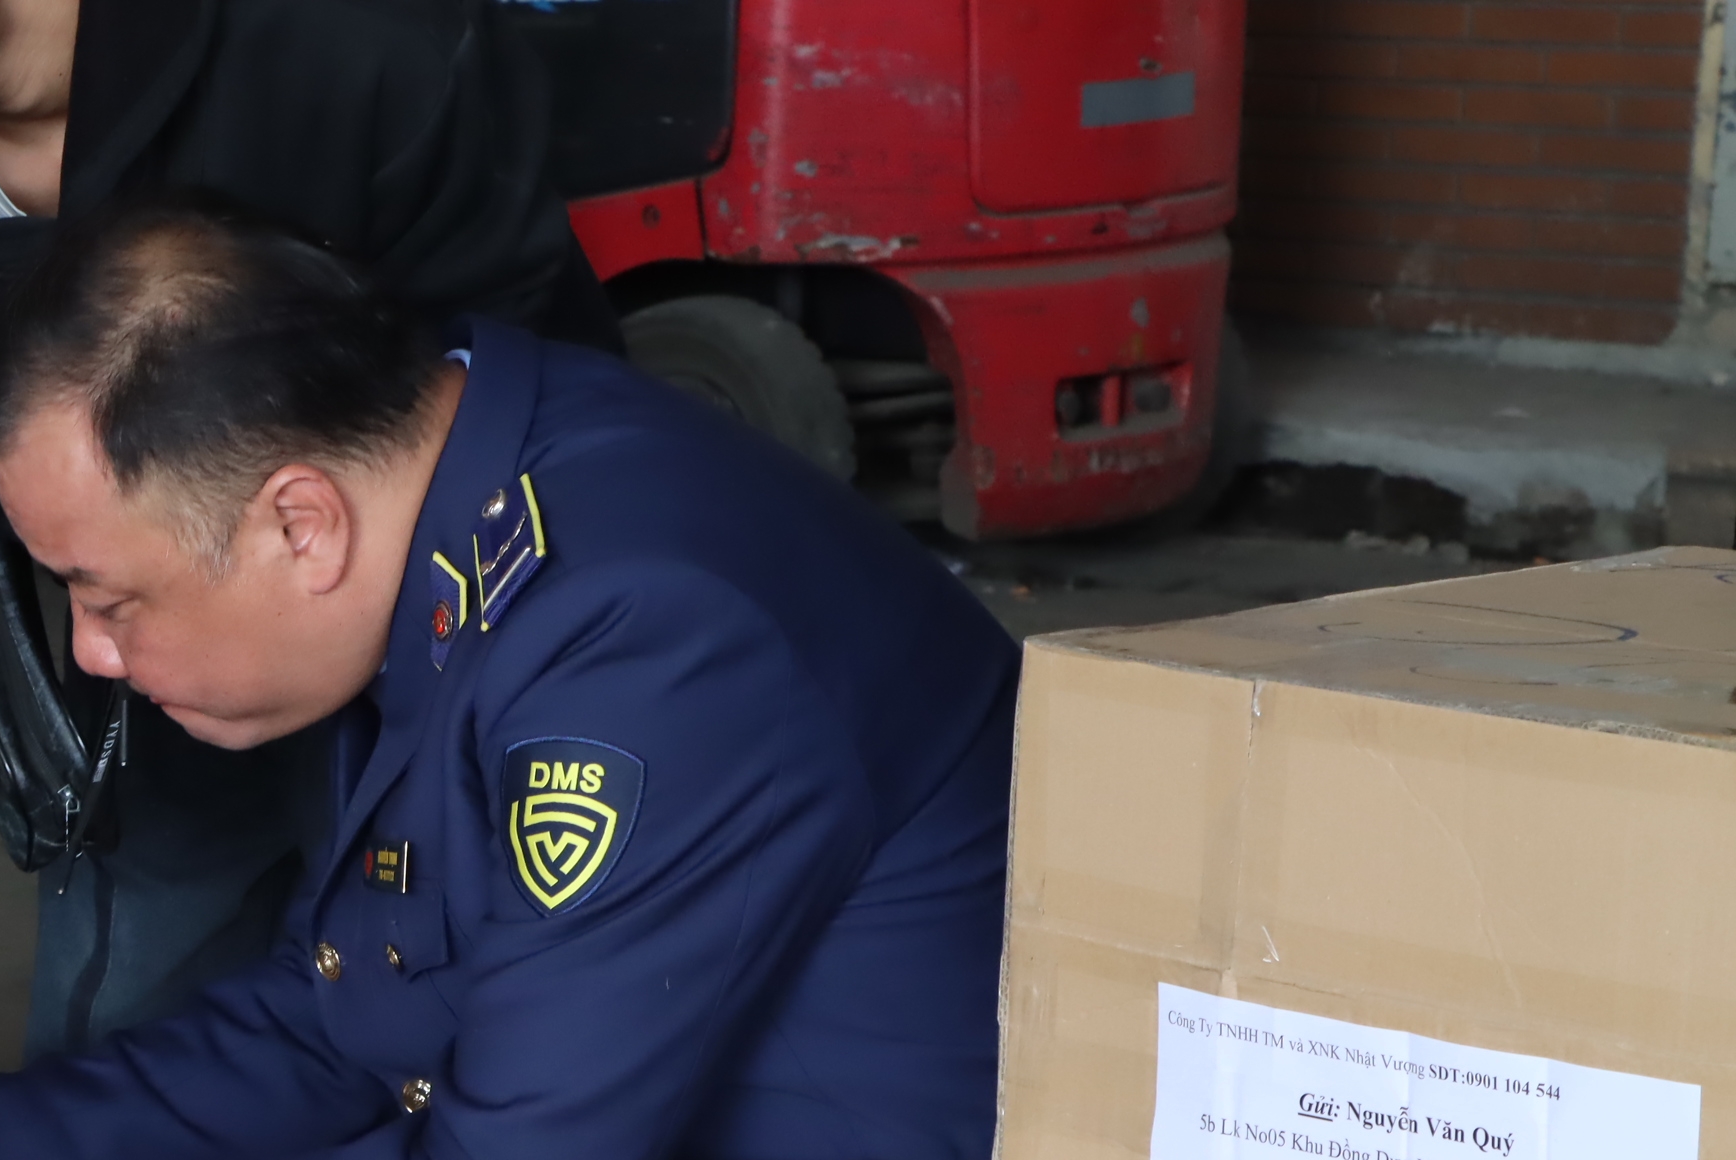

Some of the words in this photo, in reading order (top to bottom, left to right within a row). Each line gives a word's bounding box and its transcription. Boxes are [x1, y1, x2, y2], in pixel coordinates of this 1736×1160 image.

[528, 761, 606, 794] DMS
[1167, 1010, 1196, 1034] Công
[1199, 1018, 1214, 1041] Ty
[1217, 1020, 1258, 1044] TNHH
[1262, 1030, 1284, 1050] TM
[1288, 1037, 1304, 1054] và
[1309, 1041, 1339, 1059] XNK
[1346, 1048, 1375, 1066] Nhật
[1382, 1055, 1424, 1079] Vượng
[1499, 1078, 1530, 1096] 104
[1536, 1083, 1560, 1100] 544
[1200, 1114, 1215, 1132] 5b
[1220, 1118, 1241, 1138] Lk
[1246, 1123, 1285, 1146] No05
[1292, 1133, 1322, 1155] Khu
[1298, 1093, 1340, 1122] Gửi:
[1348, 1101, 1418, 1133] Nguyễn
[1426, 1117, 1464, 1143] Văn
[1473, 1127, 1514, 1157] Quý
